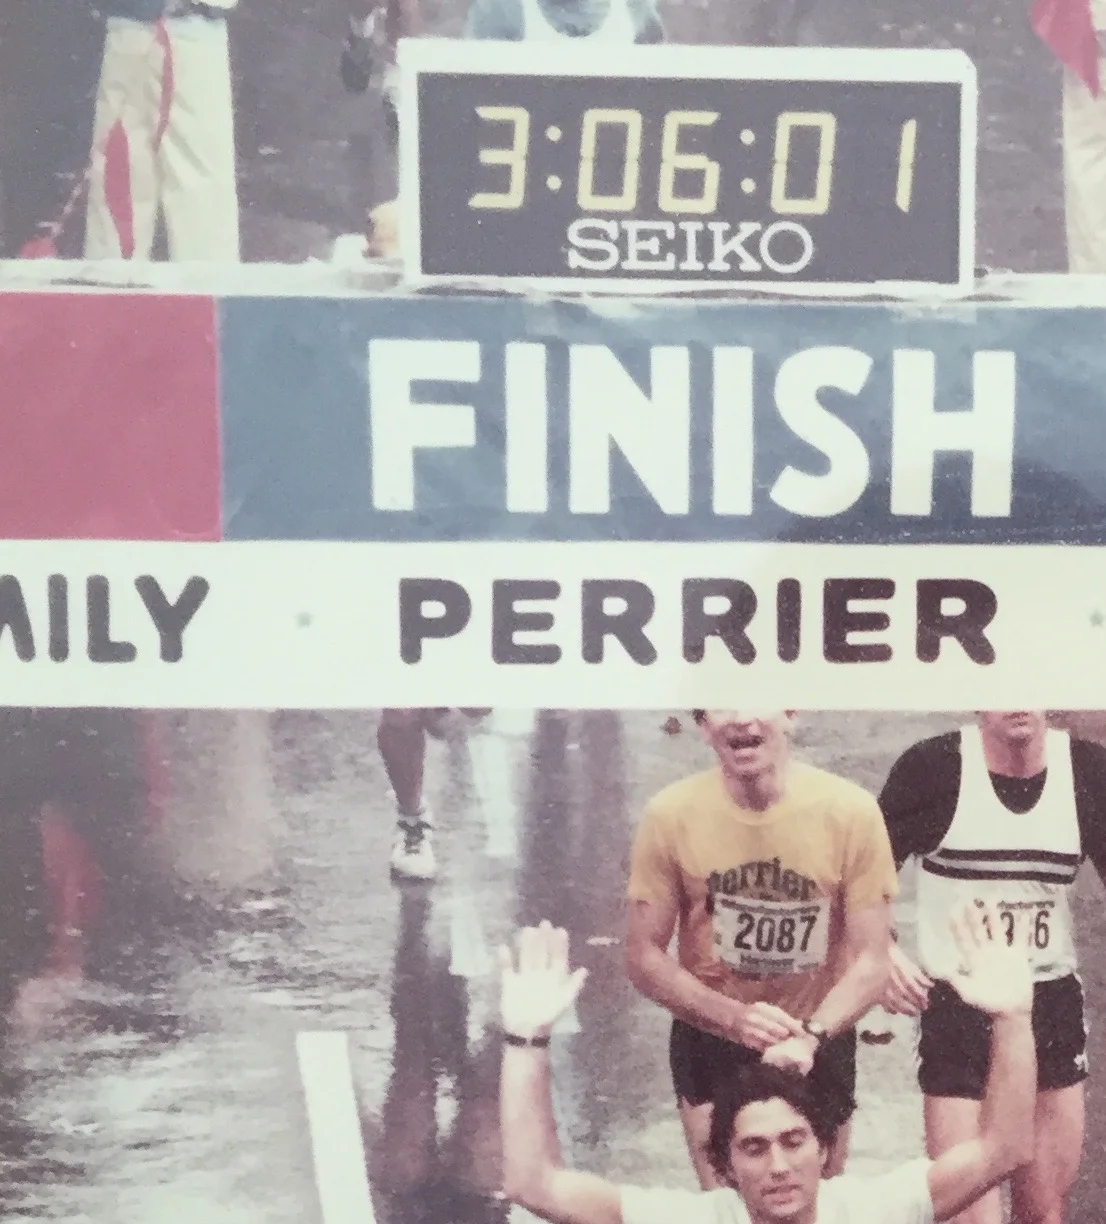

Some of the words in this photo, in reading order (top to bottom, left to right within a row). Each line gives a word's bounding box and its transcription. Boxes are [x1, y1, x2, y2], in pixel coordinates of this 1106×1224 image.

[468, 105, 917, 214] 3:06:01
[566, 217, 815, 274] SEIKO
[368, 338, 1017, 518] FINISH
[400, 577, 998, 665] PERRIER
[733, 912, 818, 953] 2087
